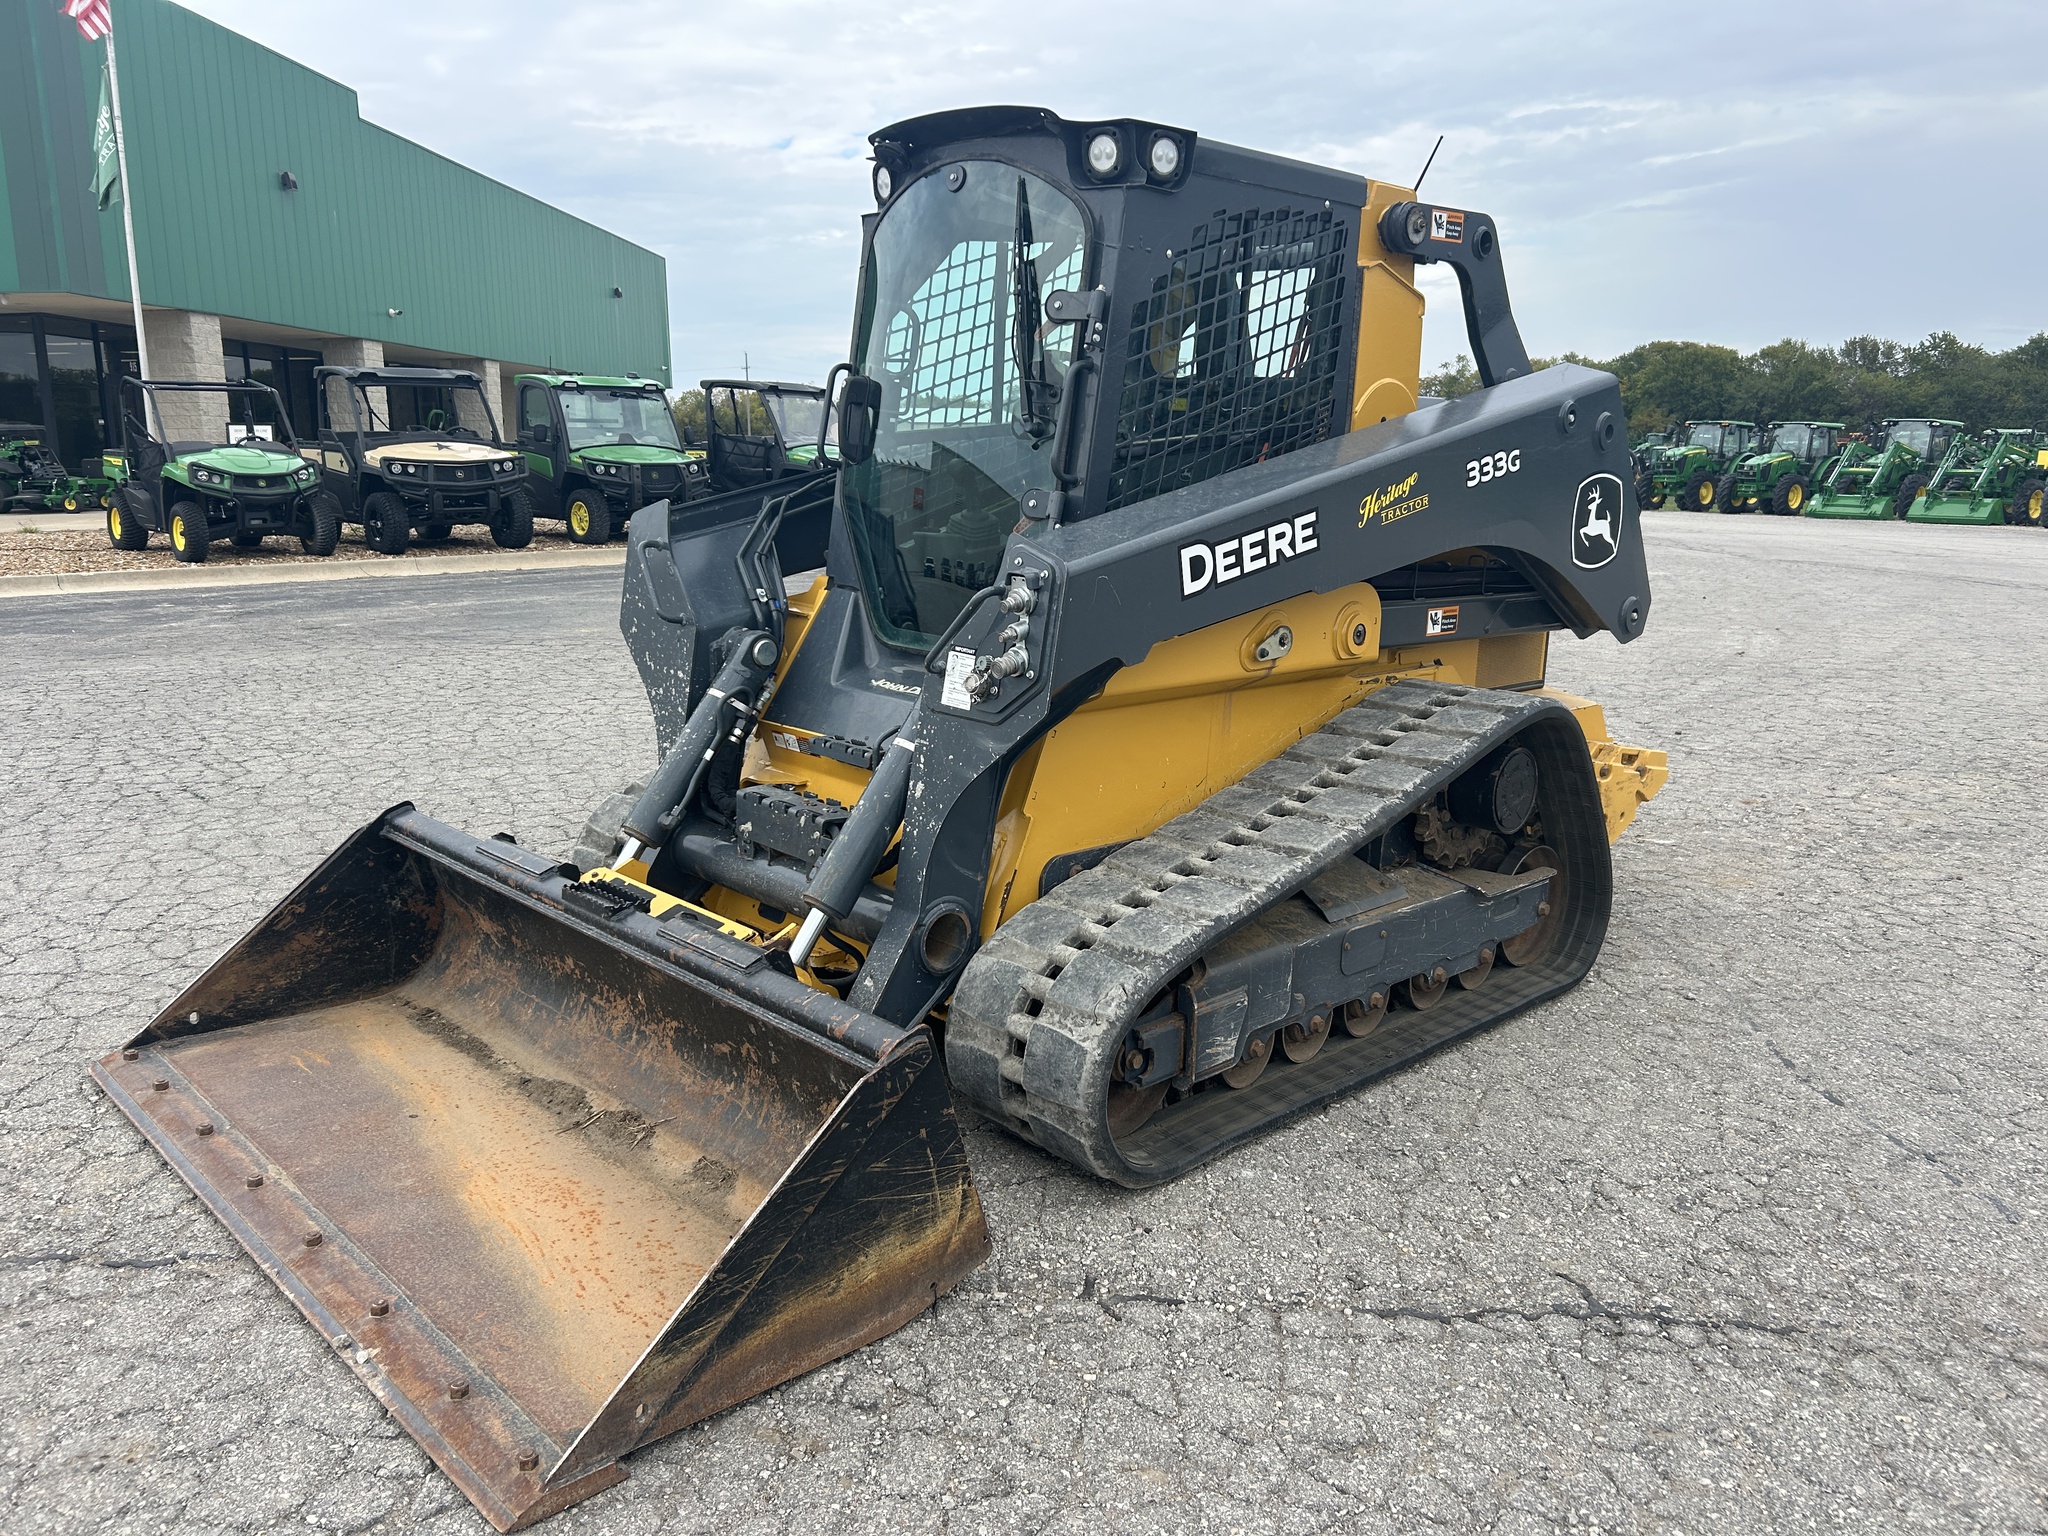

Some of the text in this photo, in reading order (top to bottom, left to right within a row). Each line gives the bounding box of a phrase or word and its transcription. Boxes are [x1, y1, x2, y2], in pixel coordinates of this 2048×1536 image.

[1466, 449, 1520, 487] 333G
[1358, 472, 1418, 529] Heritage
[1380, 496, 1429, 523] TRACTOR
[1181, 511, 1318, 596] DEERE
